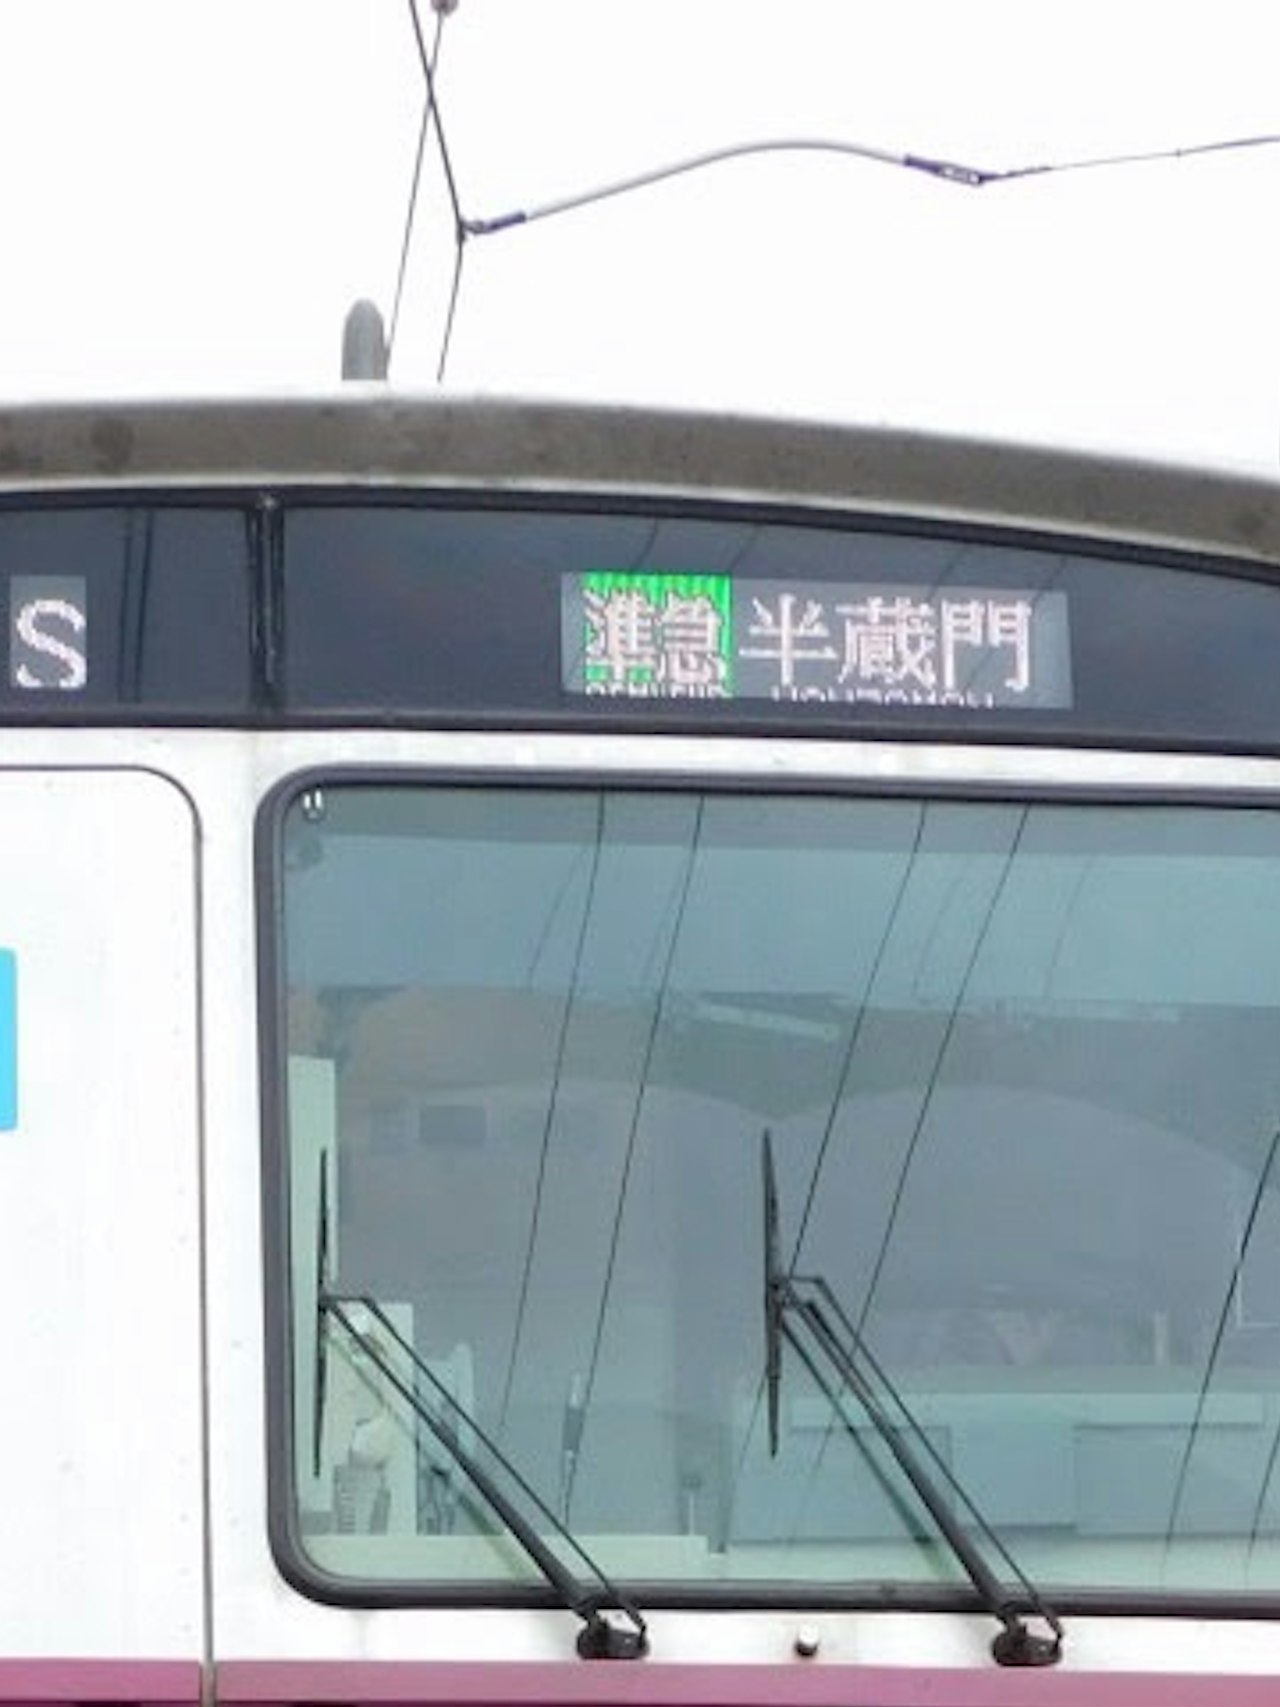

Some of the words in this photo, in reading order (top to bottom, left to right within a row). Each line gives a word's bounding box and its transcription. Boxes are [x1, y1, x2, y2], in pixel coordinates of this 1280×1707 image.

[583, 588, 729, 685] 準急
[739, 593, 1032, 693] 半蔵門
